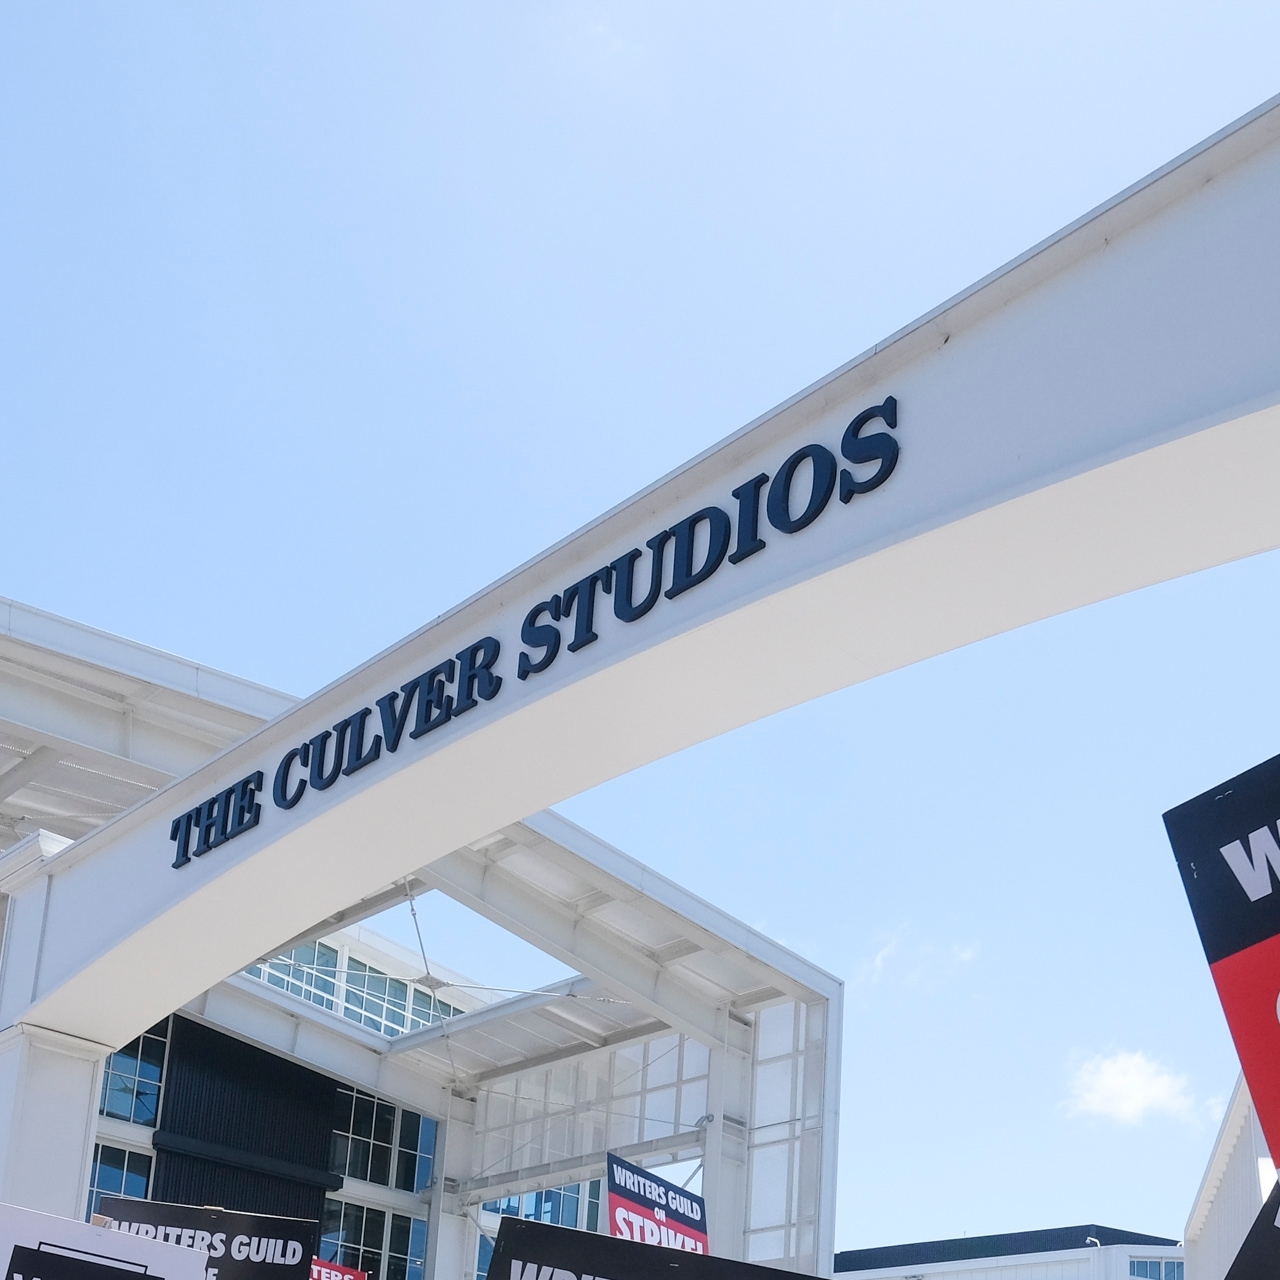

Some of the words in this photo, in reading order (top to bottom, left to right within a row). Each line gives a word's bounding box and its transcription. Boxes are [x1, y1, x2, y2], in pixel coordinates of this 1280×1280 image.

[169, 770, 264, 869] THE
[272, 635, 503, 810] CULVER
[517, 395, 900, 680] STUDIOS
[612, 1163, 667, 1205] WRITERS
[667, 1190, 702, 1221] GUILD
[654, 1207, 666, 1223] ON
[231, 1234, 303, 1265] GUILD
